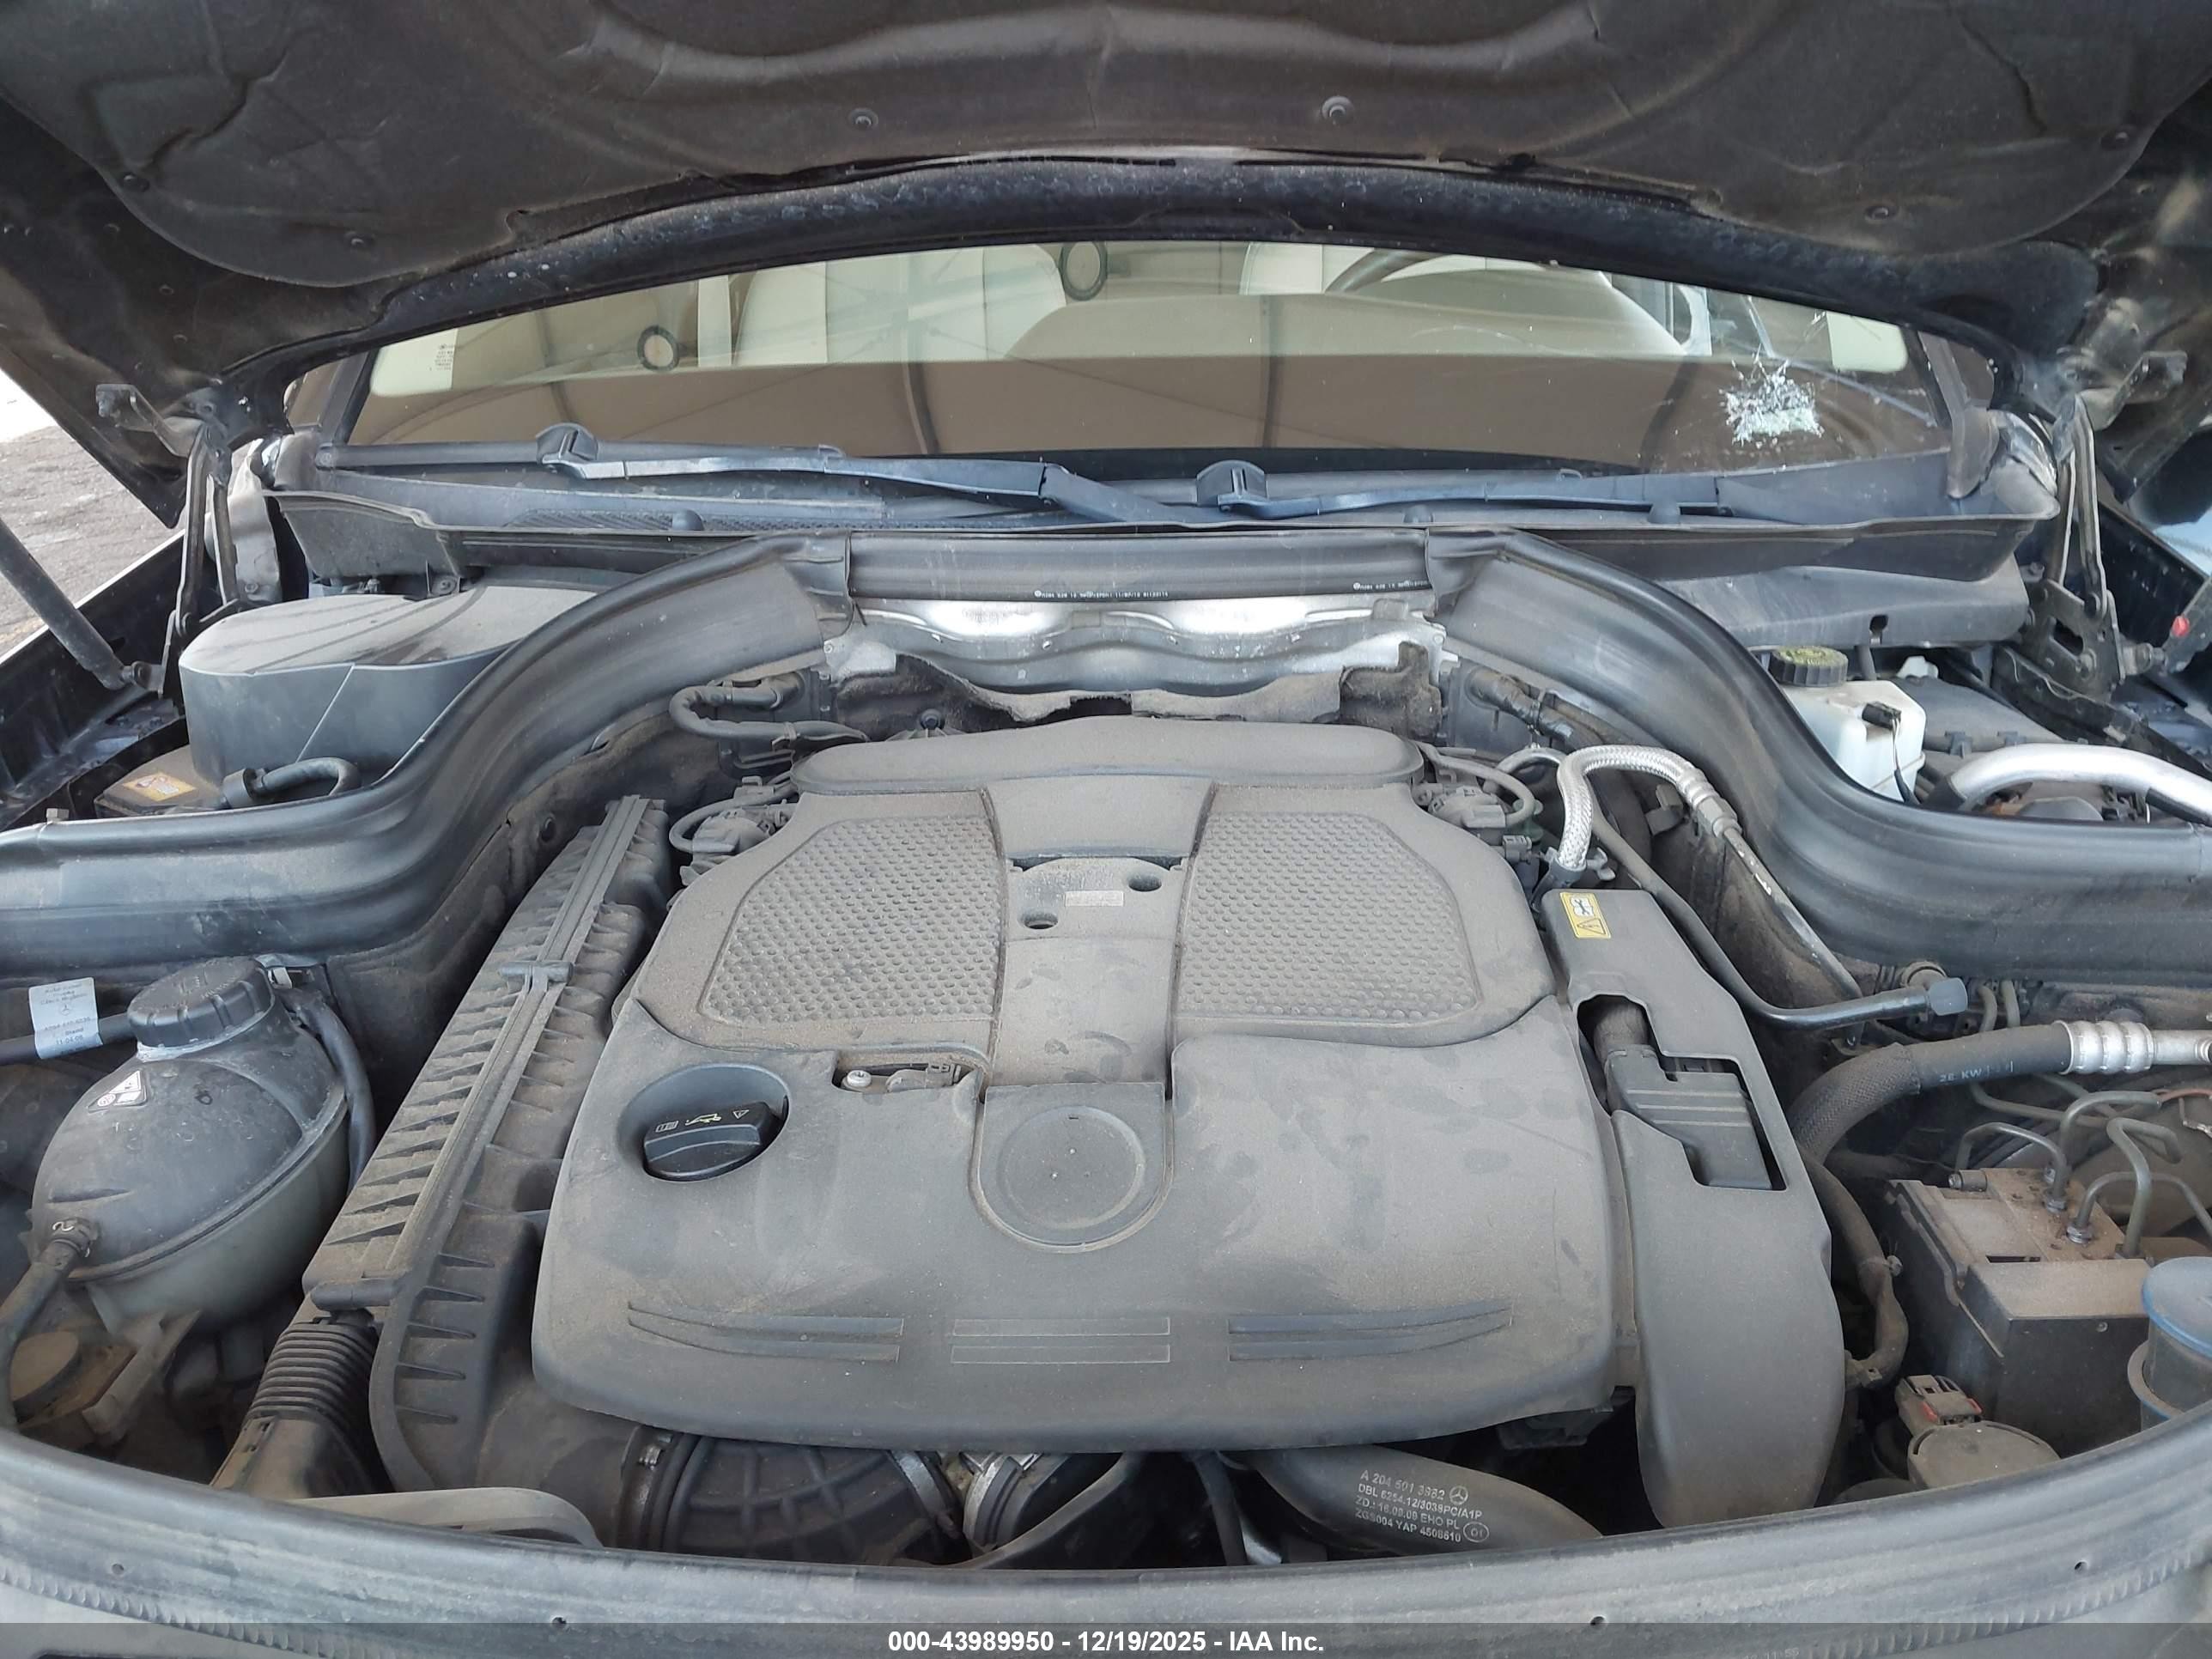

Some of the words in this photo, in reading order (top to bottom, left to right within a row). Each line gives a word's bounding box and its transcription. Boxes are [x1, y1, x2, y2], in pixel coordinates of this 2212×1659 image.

[1360, 1469, 1369, 1481] A
[1372, 1473, 1391, 1487] 204
[1395, 1480, 1414, 1493] 501
[1358, 1483, 1378, 1498] DBL
[1395, 1519, 1418, 1533] YAP
[1420, 1512, 1443, 1526] EHO
[1446, 1518, 1461, 1529] PL
